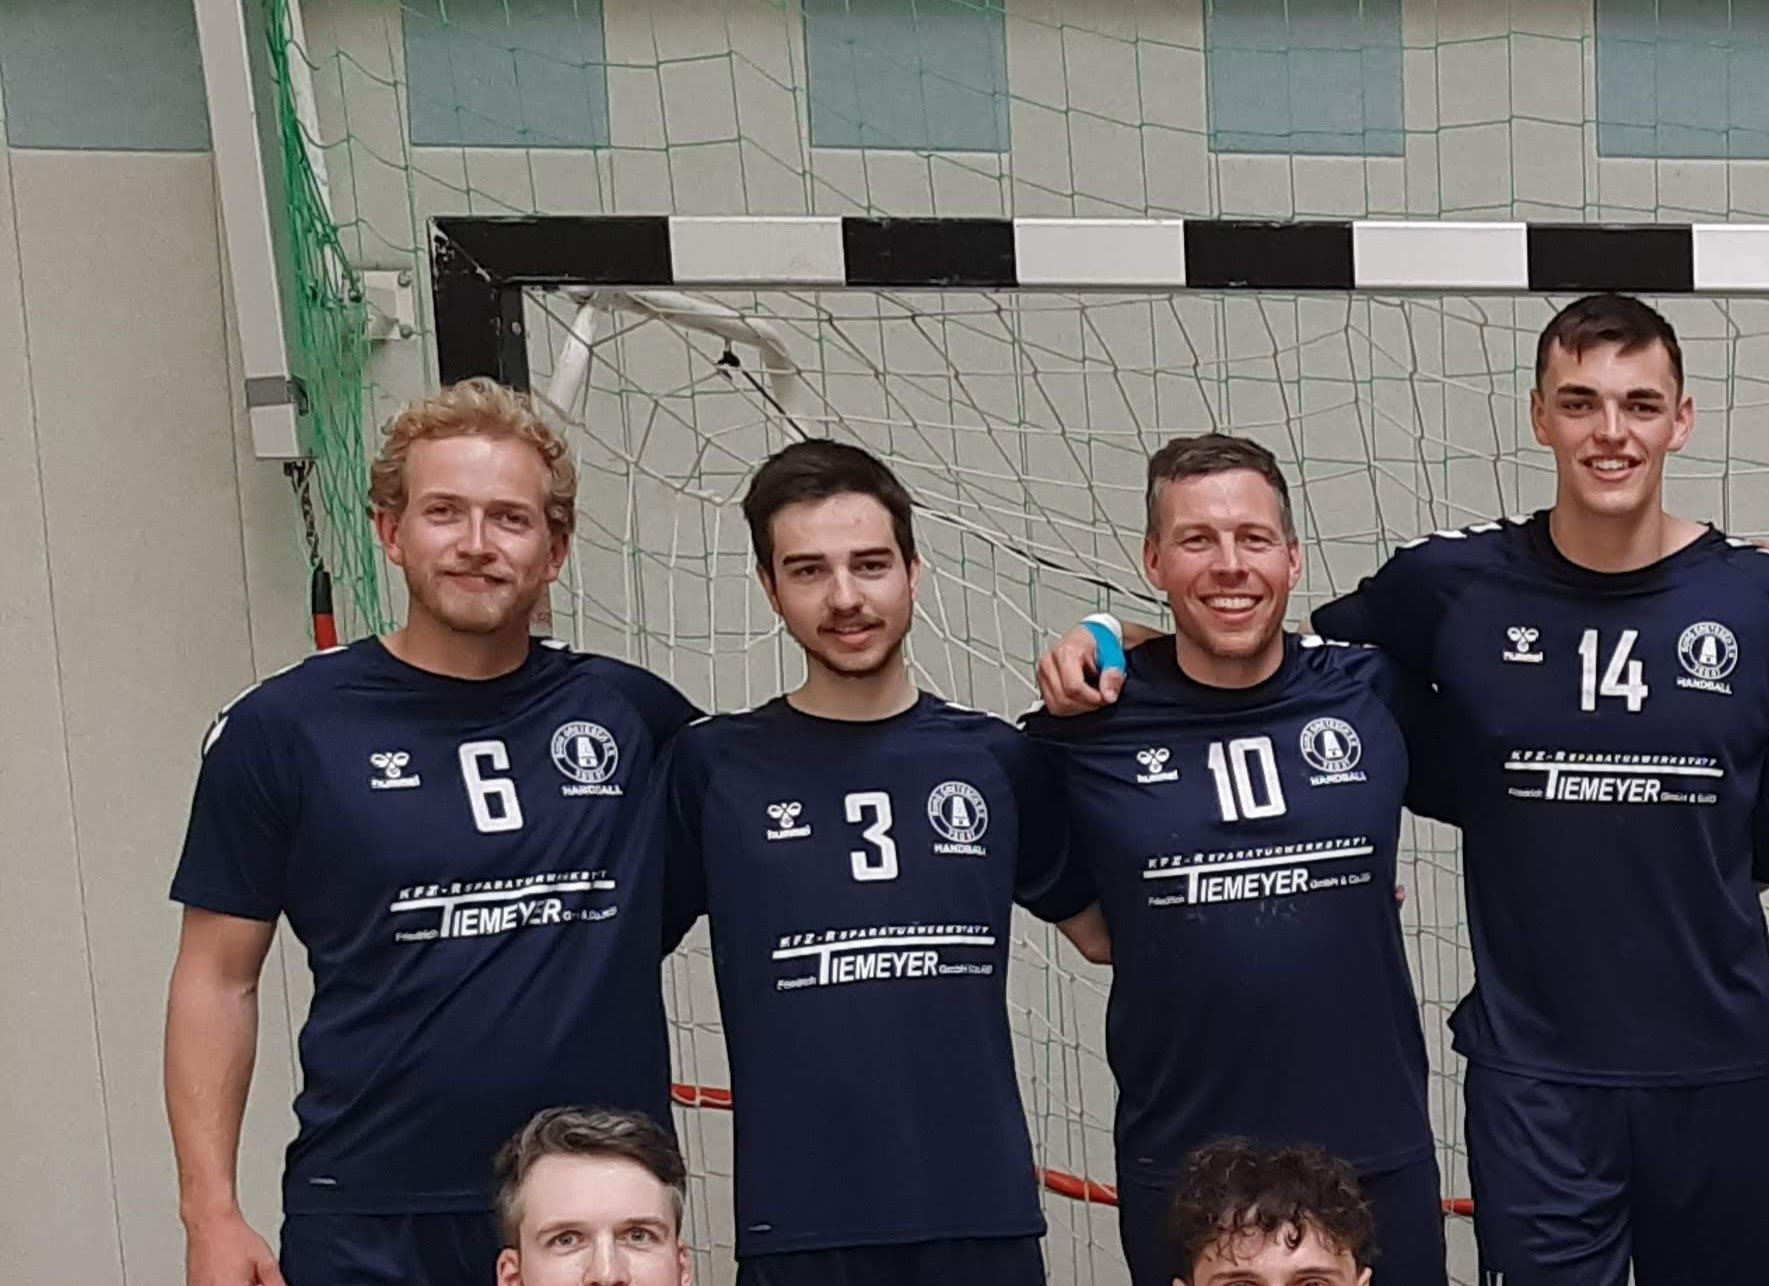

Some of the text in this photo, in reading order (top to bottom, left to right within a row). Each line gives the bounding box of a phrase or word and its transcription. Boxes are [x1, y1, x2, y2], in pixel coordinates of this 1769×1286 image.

[1578, 629, 1648, 711] 14
[459, 740, 524, 833] 6
[1208, 736, 1286, 820] 10
[1545, 769, 1661, 802] TIEMEYER
[845, 791, 898, 880] 3
[1188, 868, 1309, 904] TIEMEYER
[440, 898, 561, 938] TIEMEYER
[819, 951, 939, 985] TIEMEYER
